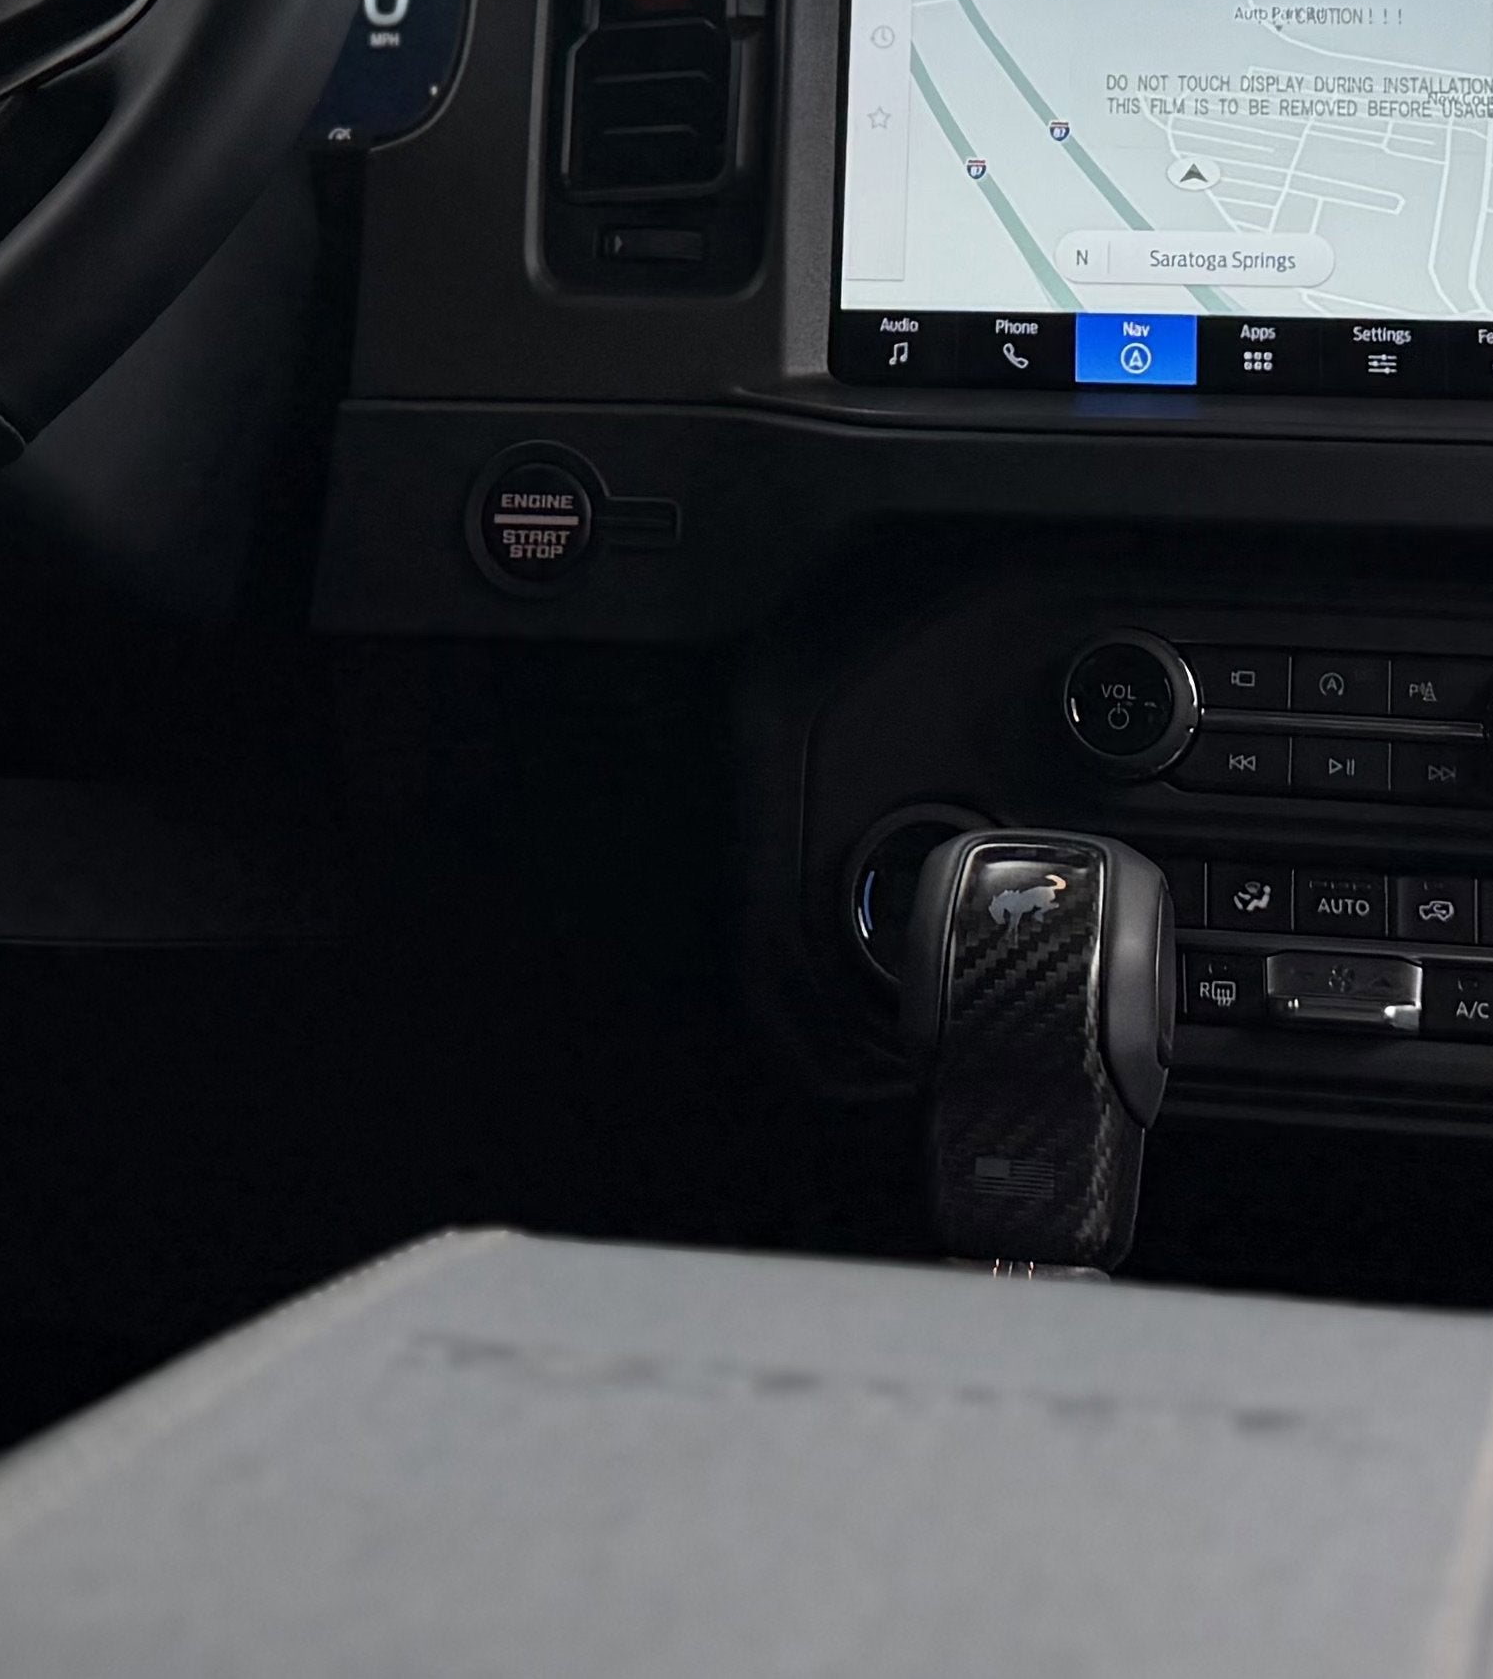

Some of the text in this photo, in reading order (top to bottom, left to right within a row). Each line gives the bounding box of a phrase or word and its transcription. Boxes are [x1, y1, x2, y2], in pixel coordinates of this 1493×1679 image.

[369, 33, 401, 49] MPH
[1106, 74, 1128, 91] DO
[1137, 74, 1169, 92] NOT
[1178, 75, 1230, 92] TOUCH
[1240, 75, 1305, 93] DISPLAY
[1313, 76, 1374, 94] DURING
[1108, 97, 1141, 114] THIS
[1150, 98, 1186, 115] FILM
[1194, 98, 1209, 115] IS
[1219, 98, 1239, 115] TO
[1248, 99, 1270, 116] BE
[1279, 99, 1357, 117] REMOVED
[1367, 100, 1431, 118] BEFORE
[1075, 250, 1297, 273] N Saratoga Springs
[880, 317, 919, 333] Audio
[995, 319, 1038, 335] Phone
[1122, 321, 1150, 336] Nav
[1240, 324, 1276, 343] Apps
[1352, 326, 1412, 345] Settings
[501, 493, 575, 510] ENGINE
[502, 529, 571, 545] START
[509, 544, 564, 559] STOP
[1101, 683, 1137, 701] VOL
[1316, 897, 1371, 917] AUTO
[1200, 982, 1210, 997] R
[1456, 1000, 1490, 1020] A/C
